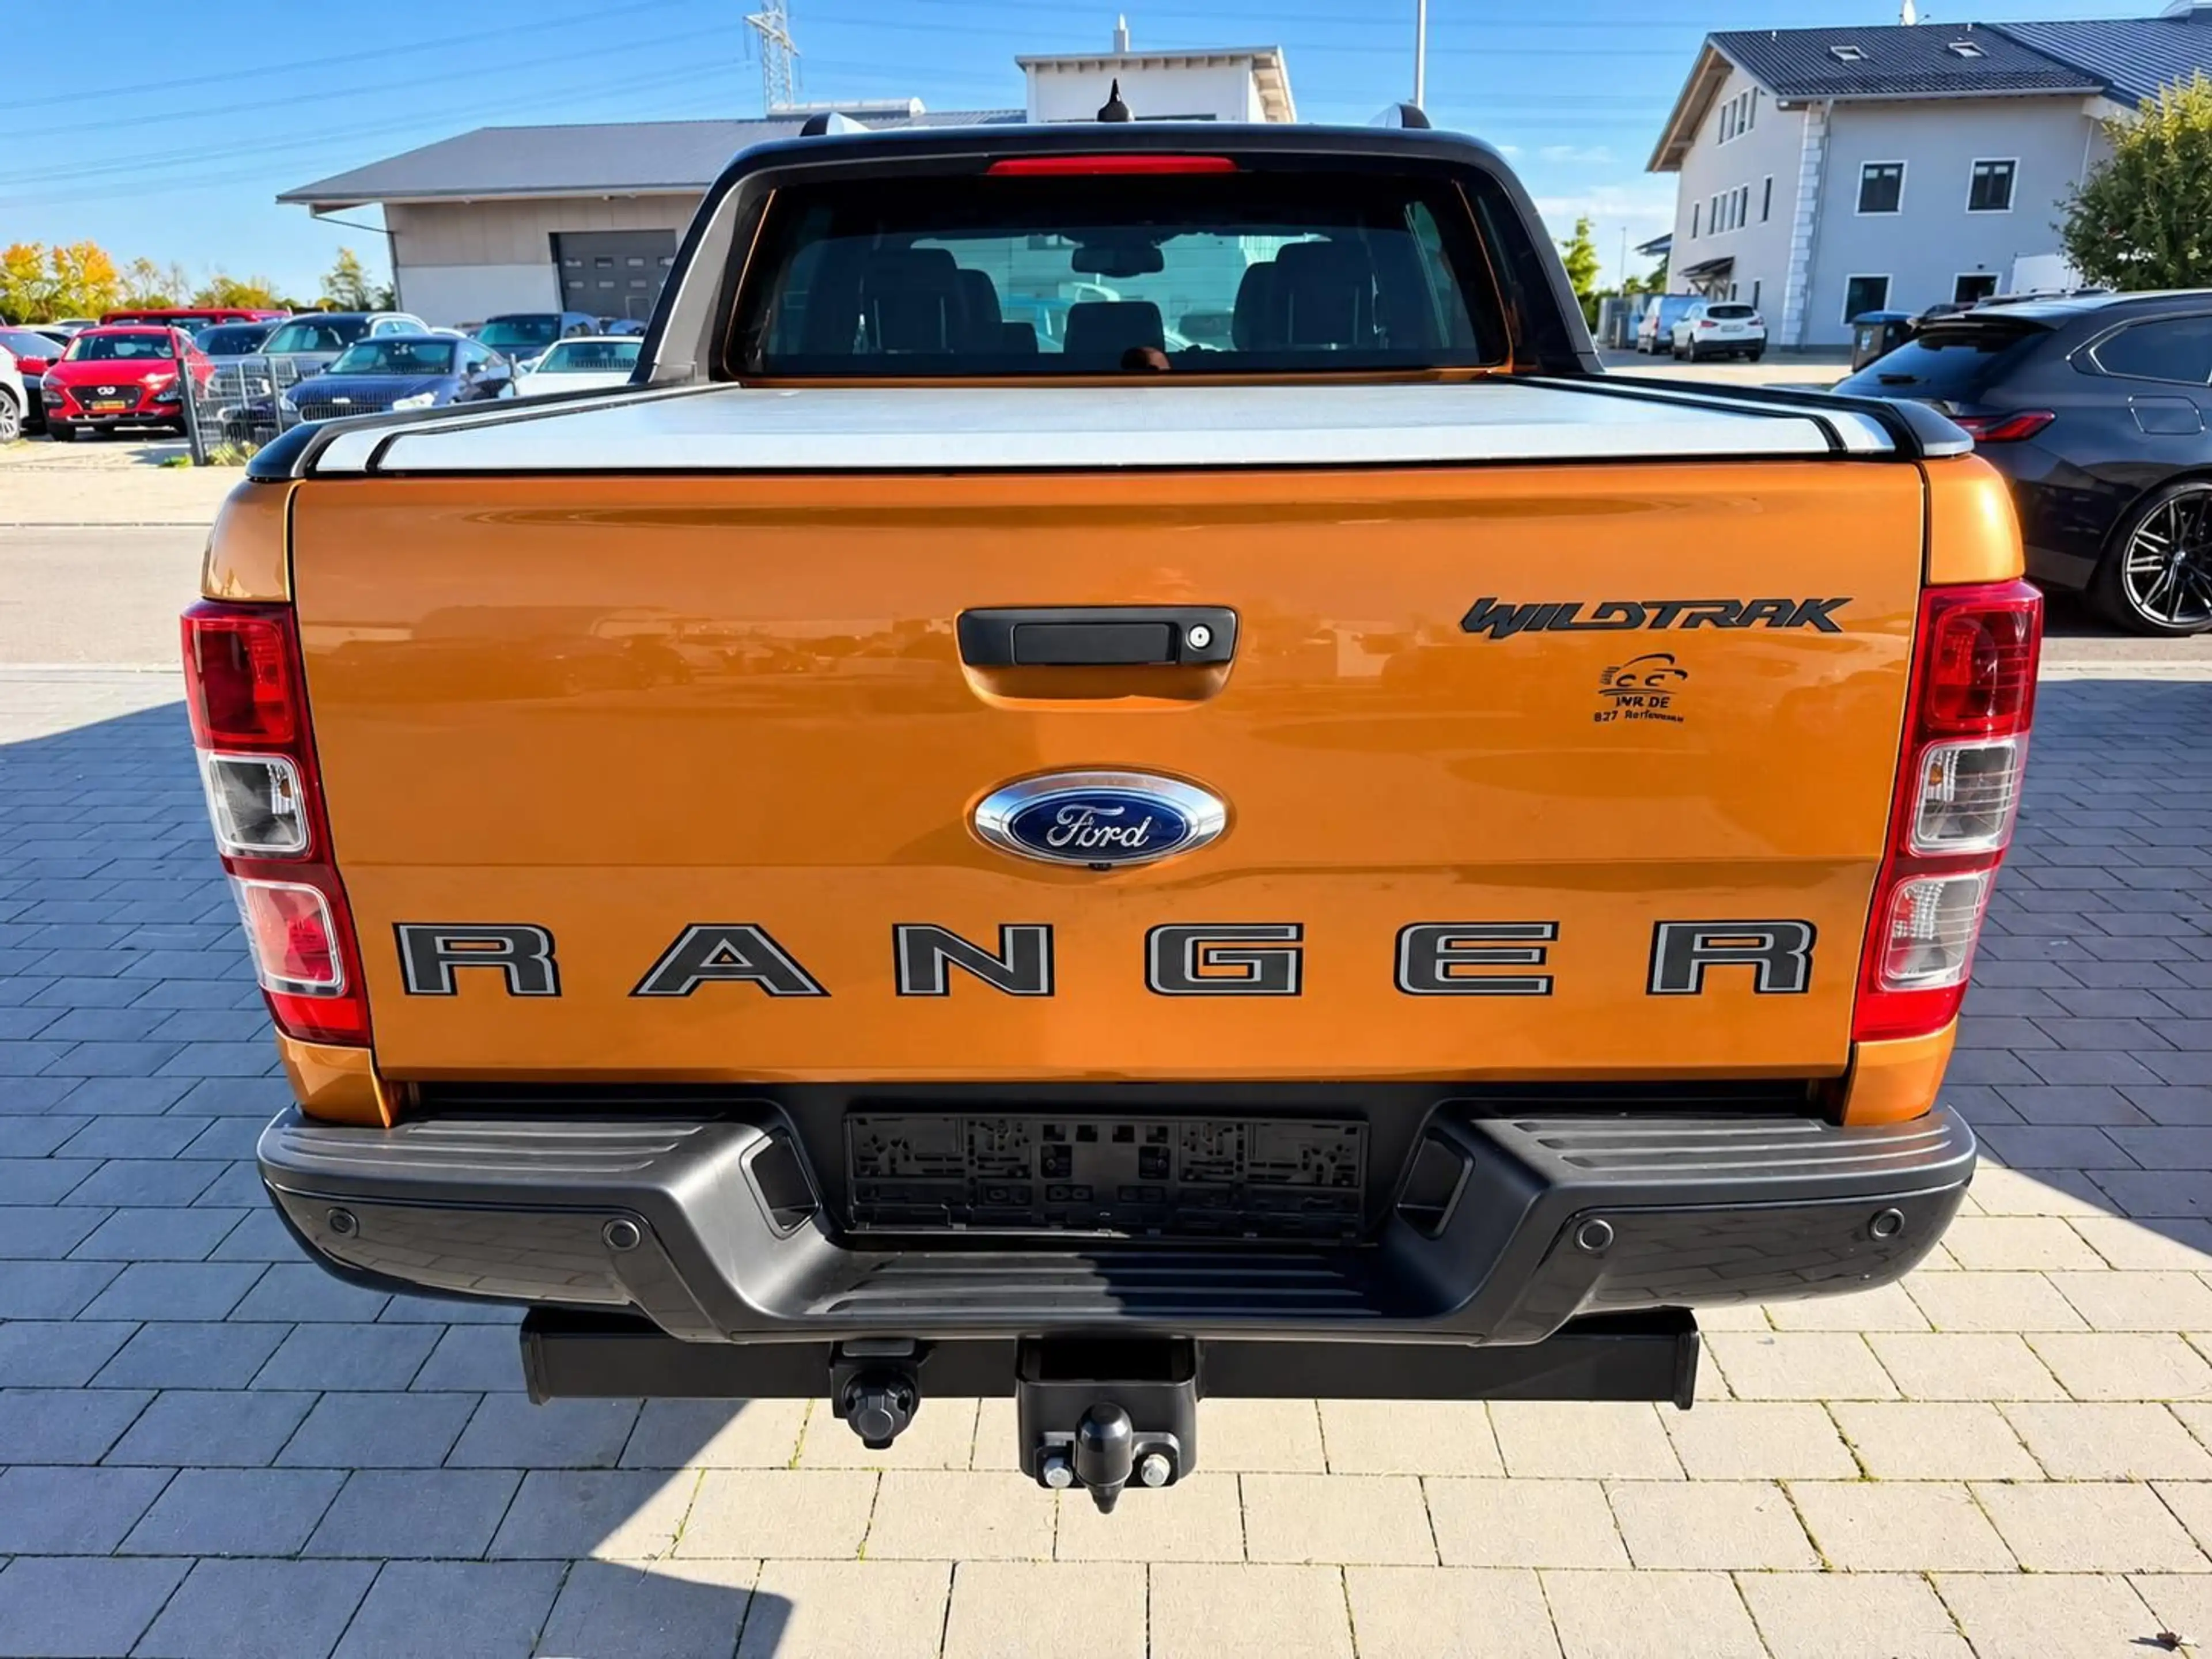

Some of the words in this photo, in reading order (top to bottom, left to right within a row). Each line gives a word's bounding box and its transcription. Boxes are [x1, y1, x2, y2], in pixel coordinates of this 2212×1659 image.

[1460, 597, 1853, 640] WILDTRAK
[1046, 804, 1152, 847] Ford
[392, 921, 1817, 997] RANGER
